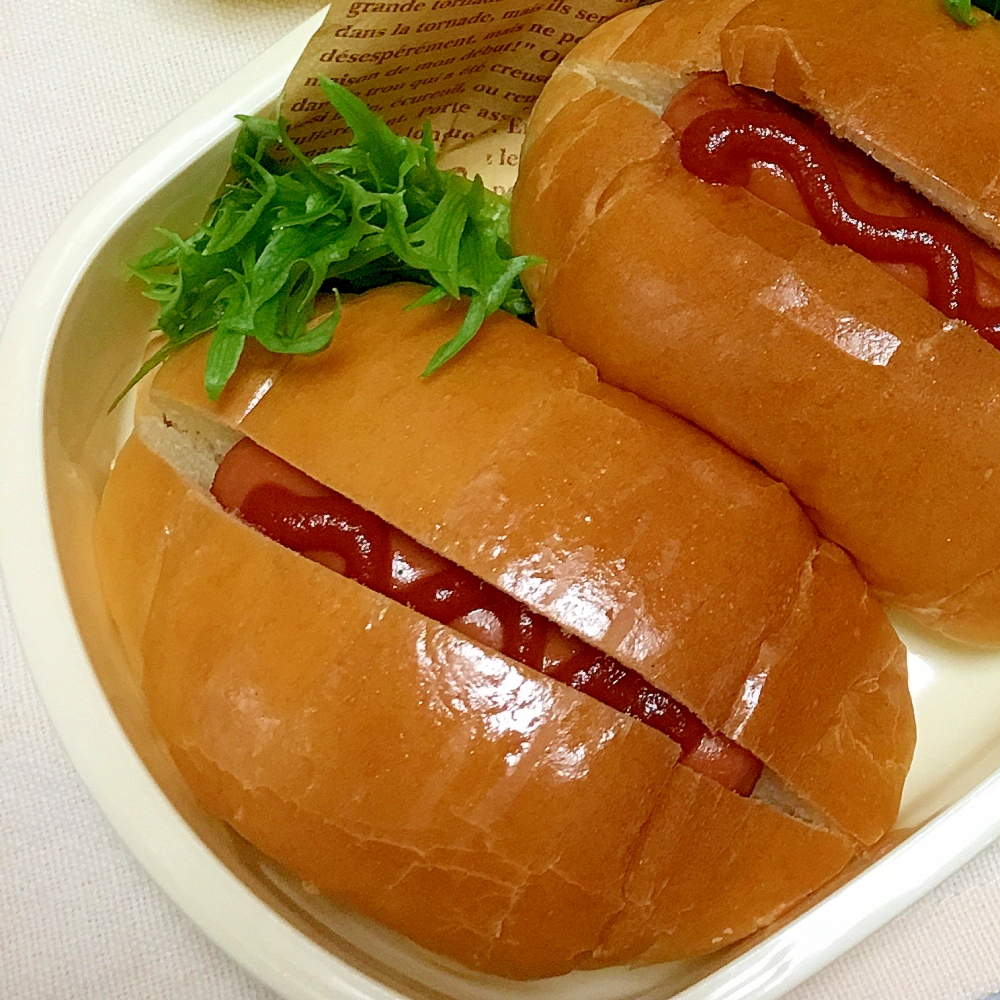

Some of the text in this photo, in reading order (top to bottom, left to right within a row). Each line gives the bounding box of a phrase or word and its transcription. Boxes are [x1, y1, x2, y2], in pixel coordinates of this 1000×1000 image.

[335, 22, 387, 39] dans
[390, 22, 411, 36] la
[416, 11, 495, 33] tornade,
[501, 3, 544, 20] mais
[483, 23, 525, 41] mais
[528, 22, 556, 37] ne
[384, 65, 411, 78] de
[413, 56, 456, 72] mon
[409, 71, 444, 91] qui
[472, 82, 499, 96] ou
